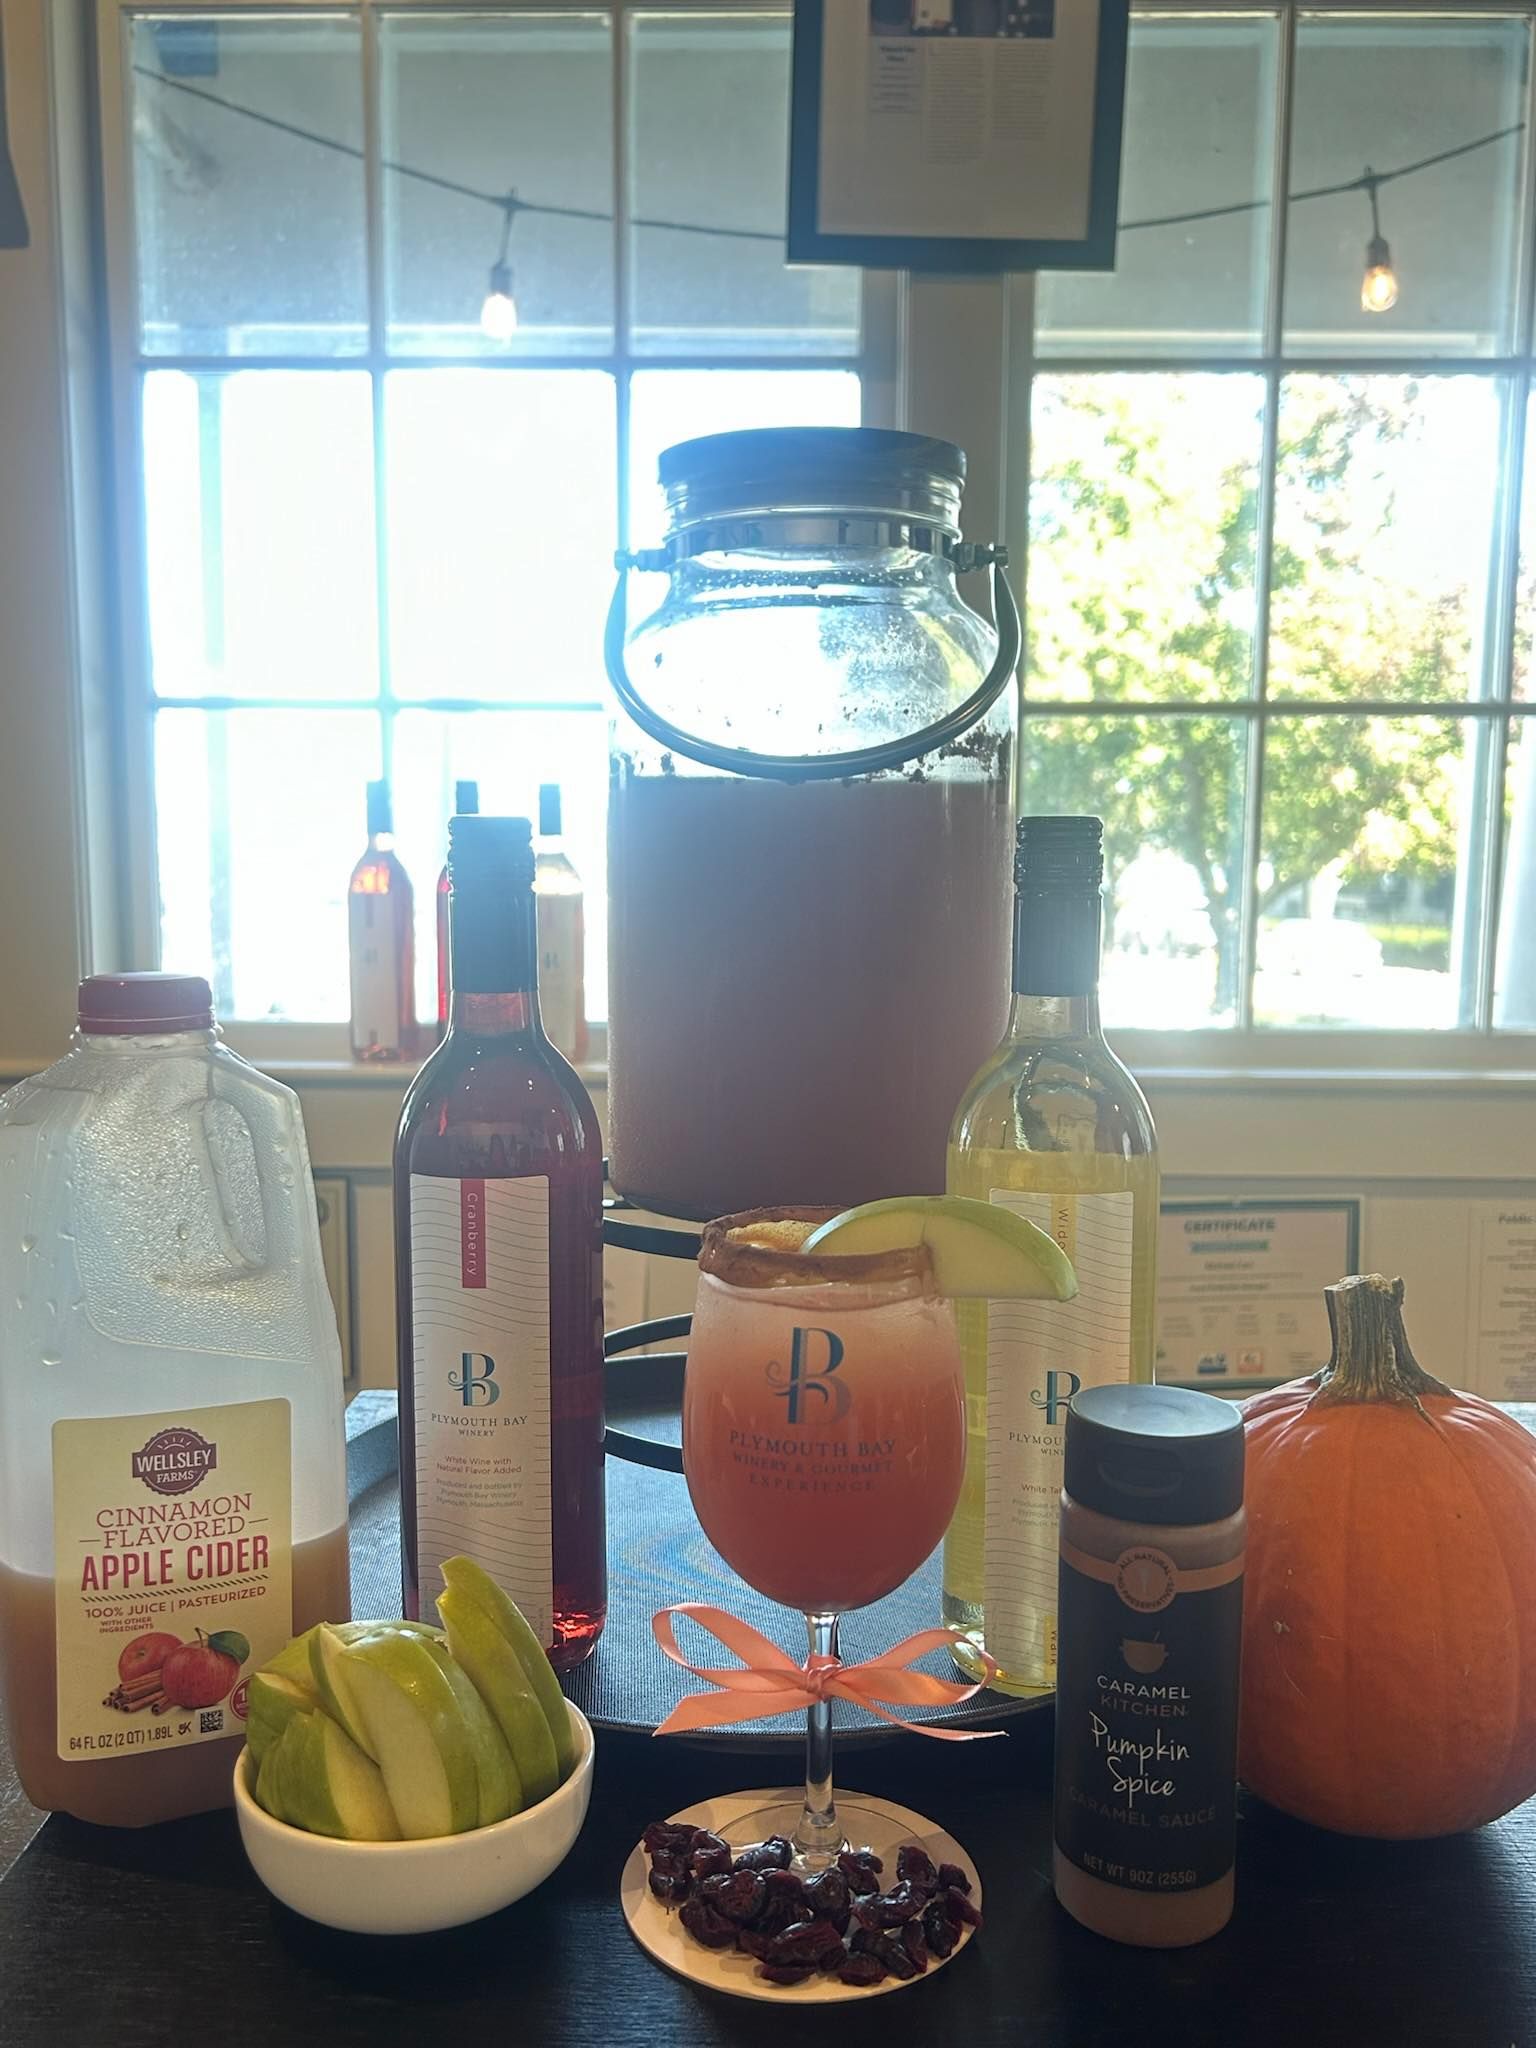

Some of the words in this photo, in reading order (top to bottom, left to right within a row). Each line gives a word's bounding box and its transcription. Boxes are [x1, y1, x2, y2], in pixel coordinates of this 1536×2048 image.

[467, 1192, 478, 1275] Cranberry
[1058, 1208, 1069, 1250] Wido
[1184, 1217, 1277, 1233] CERTIFICATE
[432, 1413, 497, 1427] PLYMOUTH
[504, 1415, 528, 1425] BAY
[459, 1429, 495, 1437] WINERY
[729, 1430, 848, 1457] PLYMOUTH
[859, 1439, 896, 1456] BAY
[1009, 1432, 1062, 1446] PLYMOU
[137, 1449, 212, 1473] WELLSLEY
[436, 1463, 463, 1473] Natural
[465, 1466, 491, 1475] Flavor
[493, 1466, 522, 1474] Added
[445, 1456, 467, 1464] White
[470, 1458, 491, 1466] Wine
[734, 1451, 788, 1472] WINERY
[811, 1460, 893, 1474] GOURMET
[157, 1470, 195, 1483] FARMS
[750, 1473, 874, 1492] EXPERIENCE
[1022, 1484, 1047, 1494] White
[96, 1493, 252, 1528] CINNAMON
[104, 1515, 245, 1549] FLAVORED
[81, 1549, 174, 1591] APPLE
[187, 1535, 269, 1581] CIDER
[85, 1606, 124, 1618] 100%
[128, 1602, 166, 1616] JUICE
[179, 1586, 266, 1609] PASTEURIZED
[99, 1623, 154, 1633] INGREDIENTS
[124, 1616, 152, 1625] OTHER
[1097, 1675, 1191, 1700] CARAMEL
[1101, 1695, 1186, 1717] KITCHEN
[70, 1736, 82, 1750] 64
[84, 1735, 96, 1748] FL
[98, 1733, 113, 1748] OZ
[148, 1725, 174, 1741] 1.89L
[1089, 1711, 1190, 1774] Pumpkin
[1107, 1757, 1176, 1808] Spice
[1069, 1785, 1151, 1826] CARAMEL
[1159, 1805, 1217, 1828] SAUCE
[1083, 1850, 1103, 1870] NET
[1106, 1863, 1126, 1878] WT
[1158, 1870, 1197, 1885] (255G)
